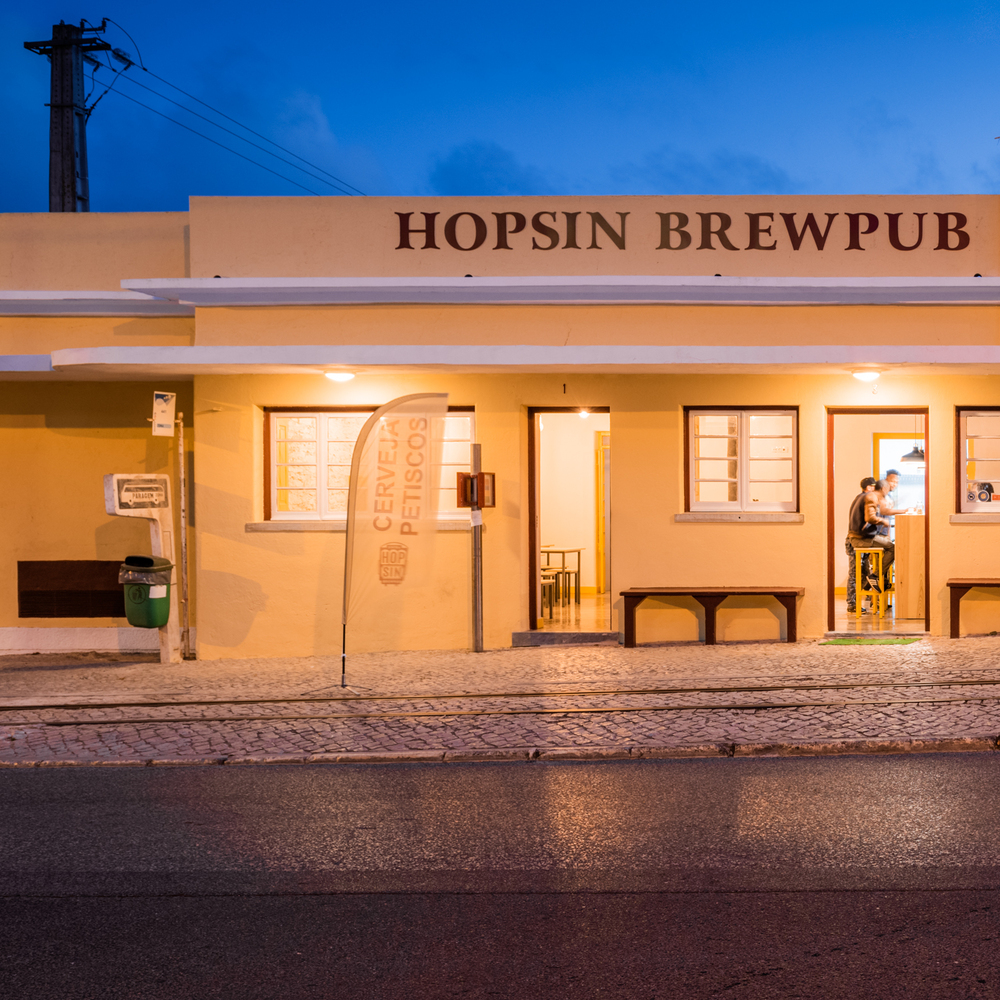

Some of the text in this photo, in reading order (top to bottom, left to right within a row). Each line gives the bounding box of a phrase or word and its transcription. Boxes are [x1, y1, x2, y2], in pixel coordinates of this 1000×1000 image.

[394, 212, 970, 251] HOPSIN BREWPUB
[373, 420, 399, 531] CERVEJA
[400, 418, 427, 536] PETISCOS
[382, 551, 405, 565] HOP
[383, 567, 402, 577] SIN
